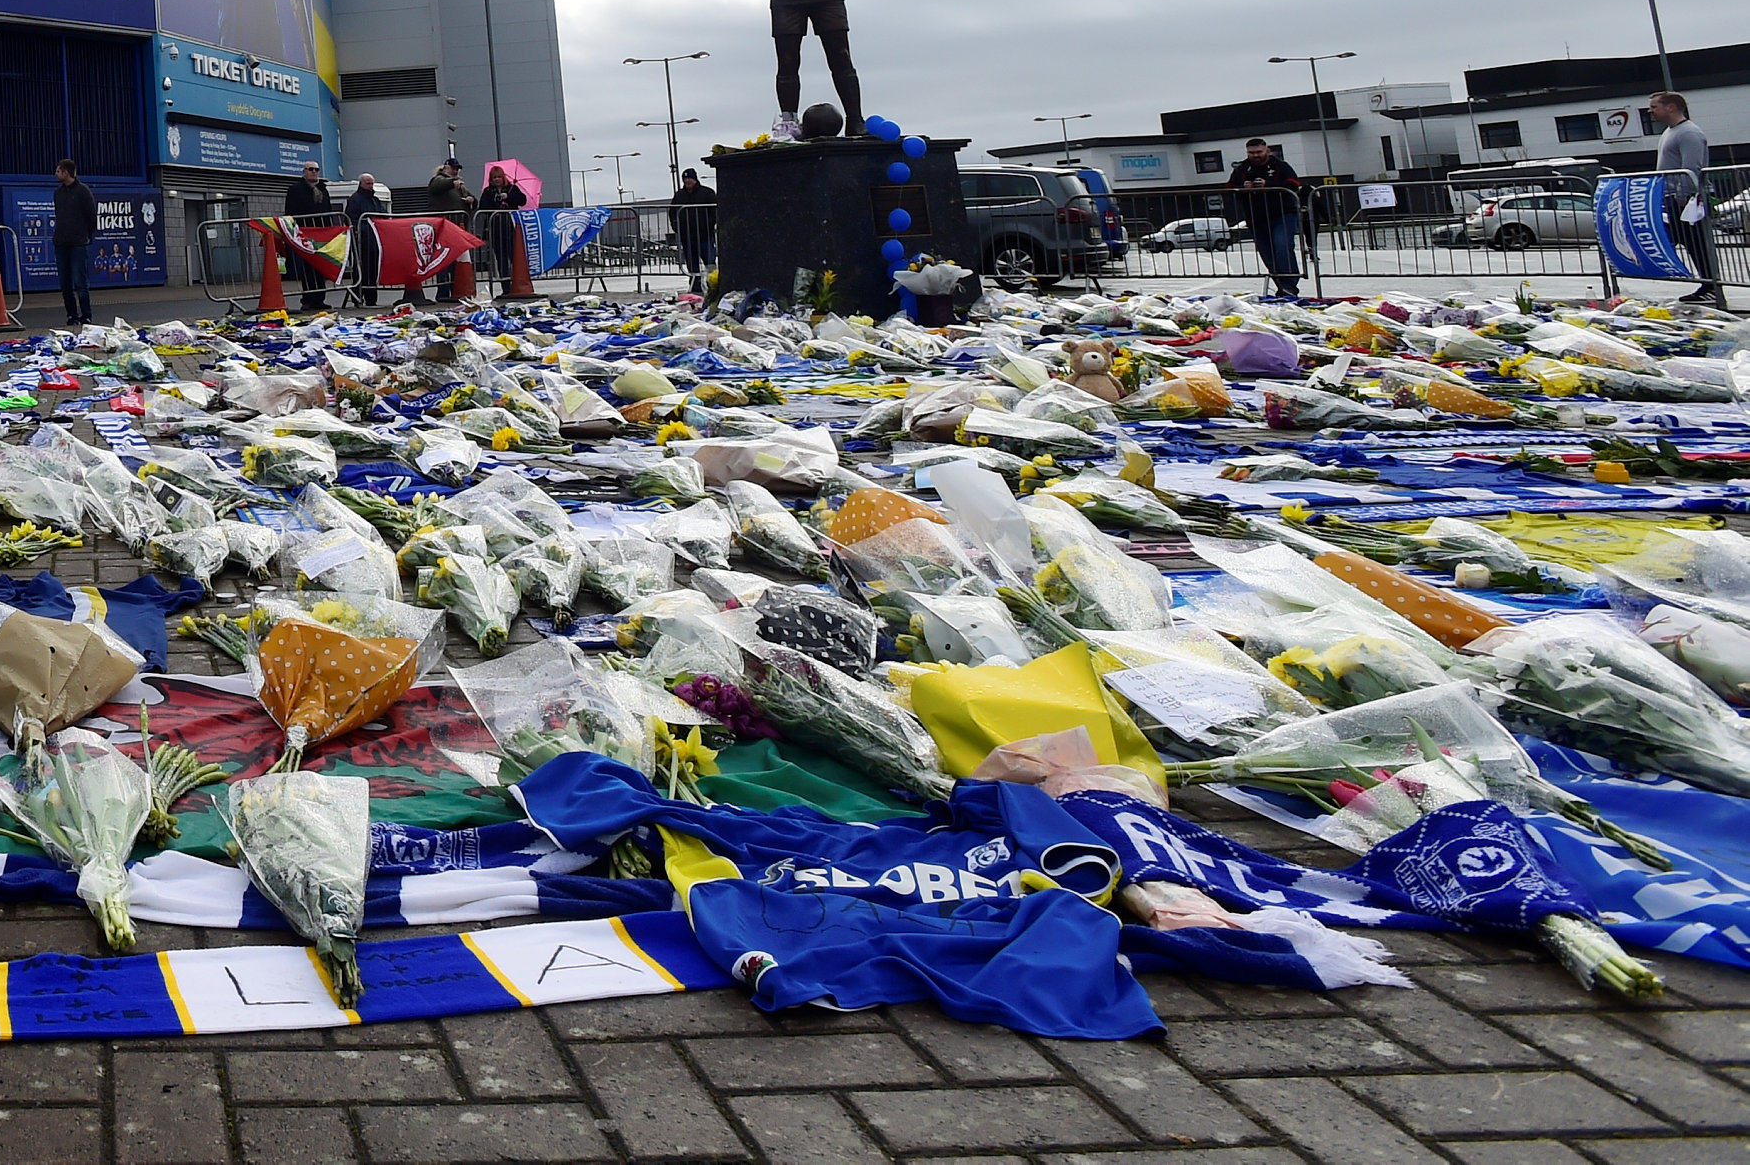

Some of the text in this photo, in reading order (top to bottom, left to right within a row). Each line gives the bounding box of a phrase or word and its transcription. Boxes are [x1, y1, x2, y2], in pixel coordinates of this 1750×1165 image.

[191, 52, 300, 95] TICKET OFFICE
[1606, 119, 1623, 127] RAS
[1122, 157, 1161, 170] maplin
[97, 202, 132, 215] MATCH
[1629, 177, 1649, 229] CARDIFF
[96, 215, 135, 230] TICKETS
[522, 210, 541, 275] CARDIFF CITY FC
[1637, 231, 1663, 259] CITY
[35, 1009, 152, 1024] LUKE
